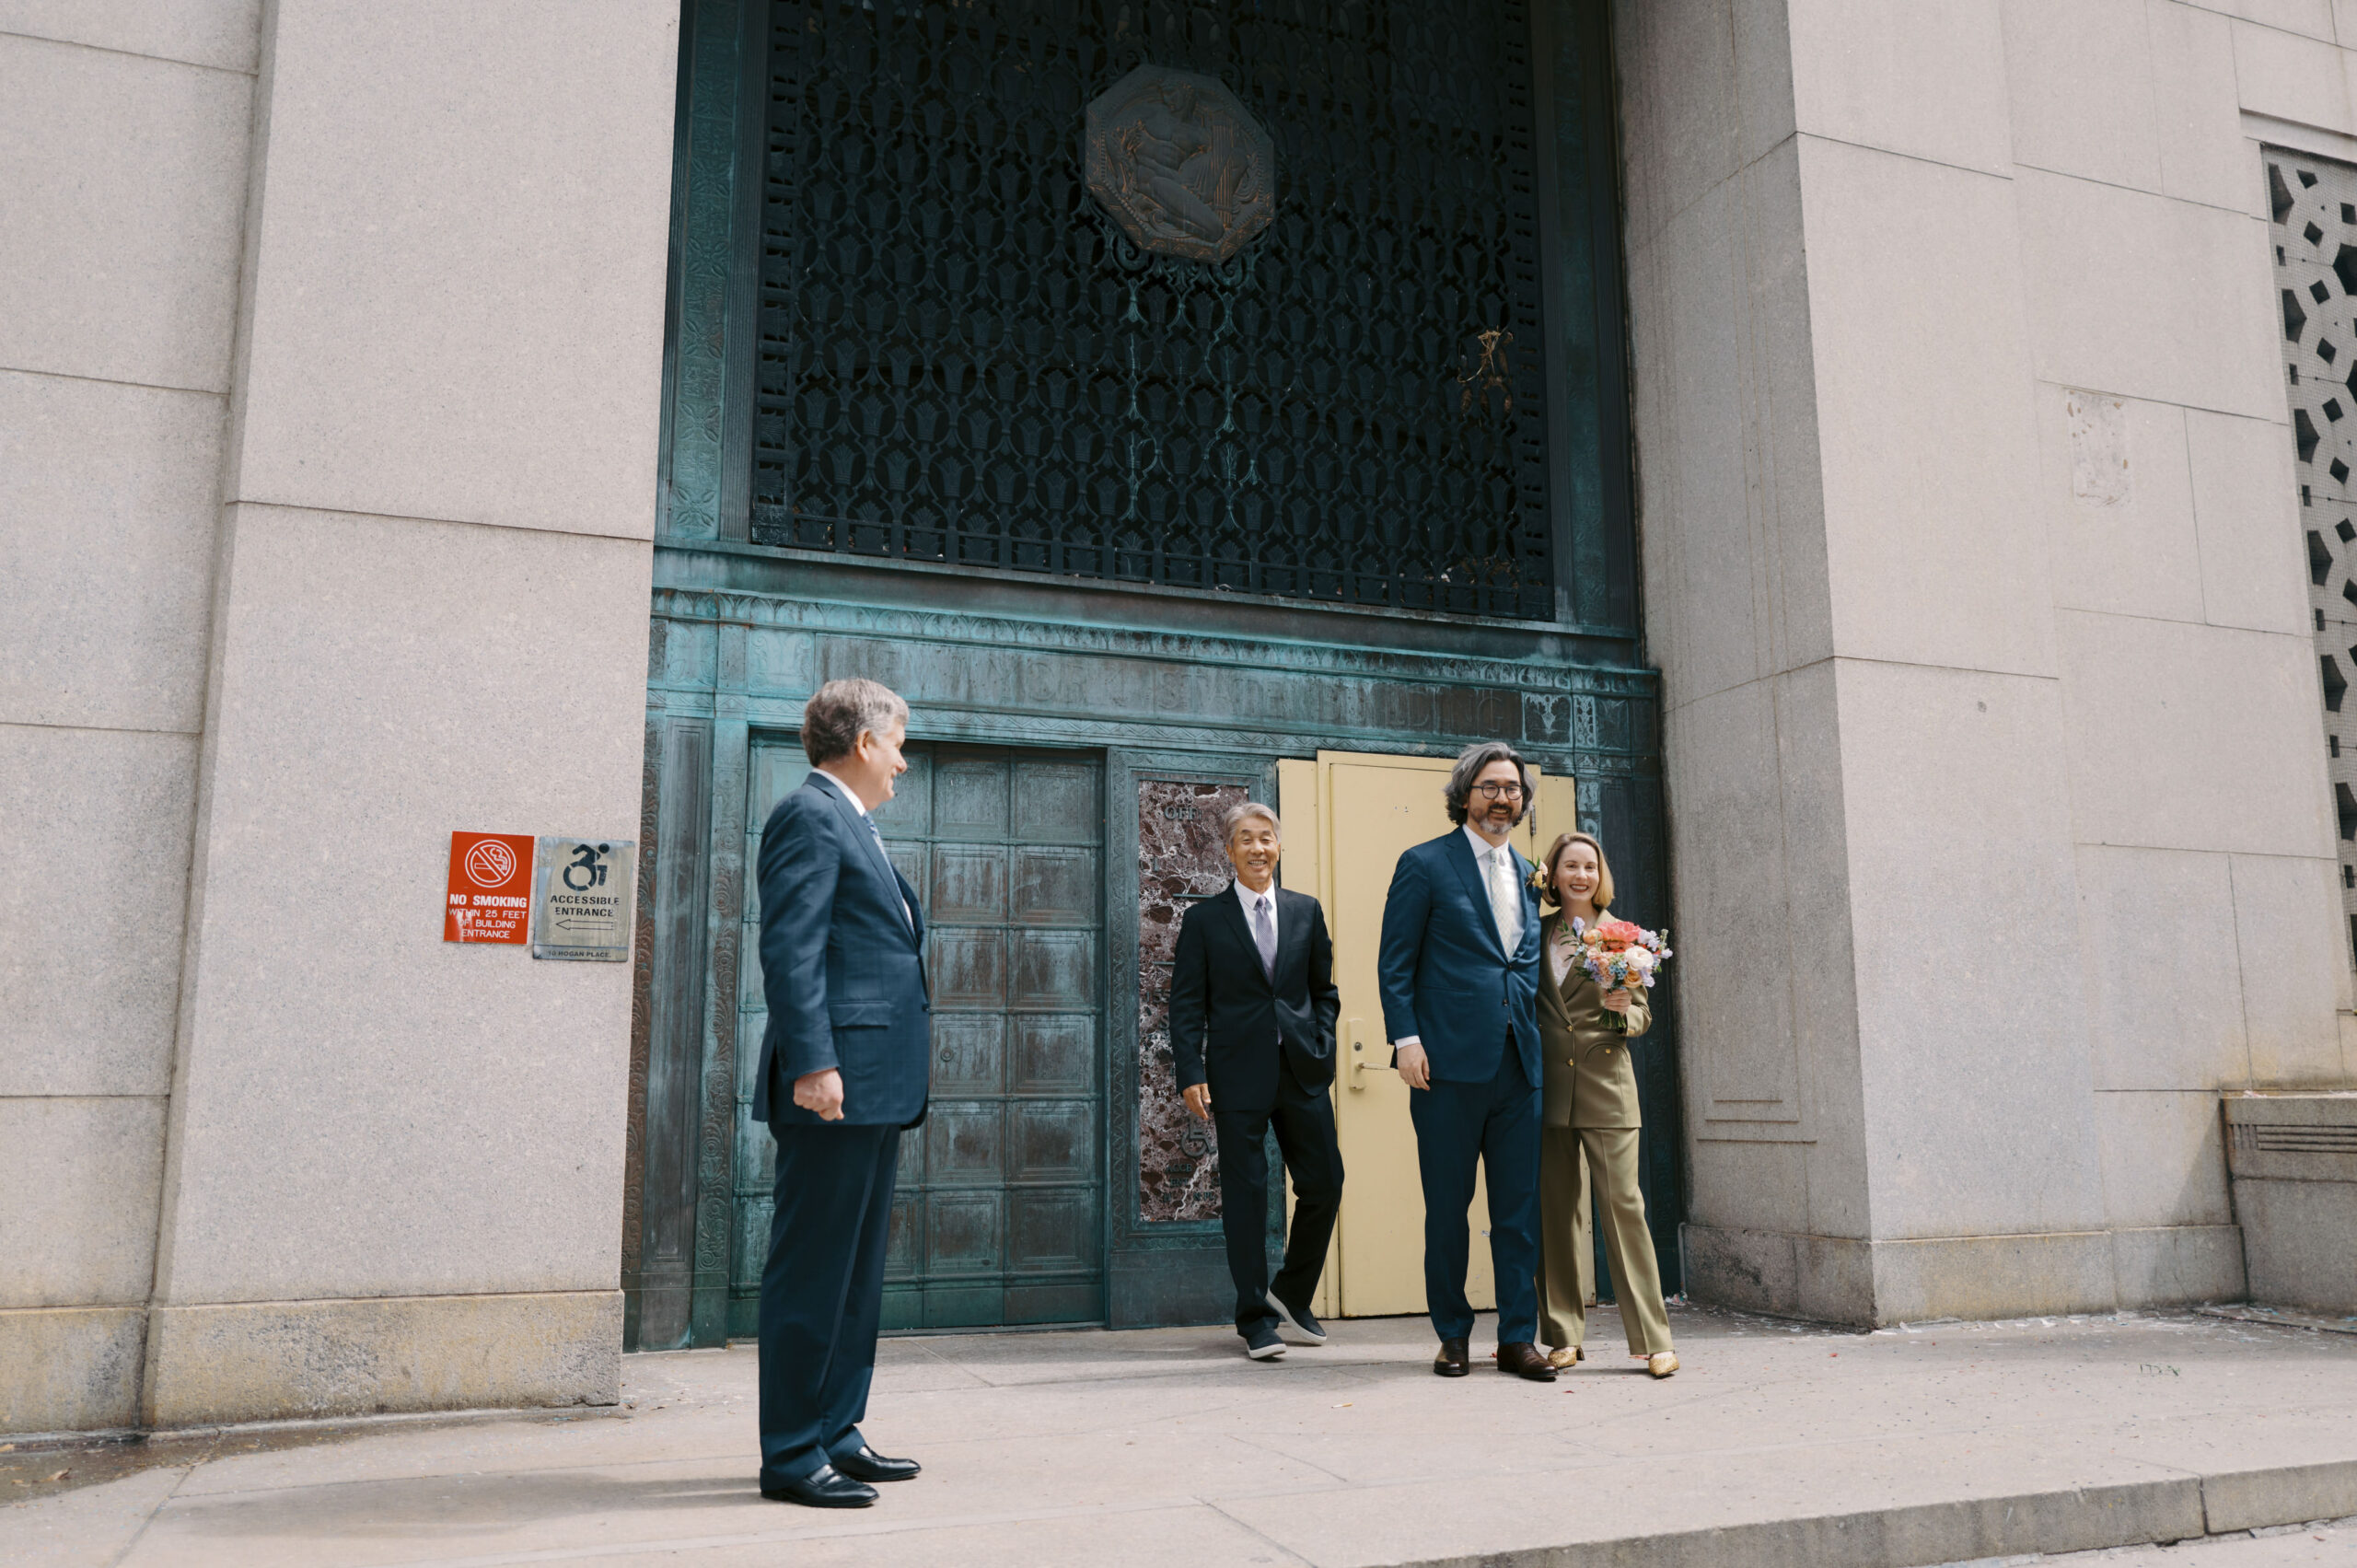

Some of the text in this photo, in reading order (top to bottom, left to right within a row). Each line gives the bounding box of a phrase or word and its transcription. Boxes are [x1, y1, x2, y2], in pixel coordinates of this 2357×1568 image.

[449, 893, 528, 908] NO SMOKING
[550, 895, 620, 906] ACCESSIBLE
[448, 908, 527, 919] WITHIN 25 FEET
[555, 906, 614, 917] ENTRANCE
[459, 919, 516, 929] OF BUILDING
[462, 928, 510, 939] ENTRANCE
